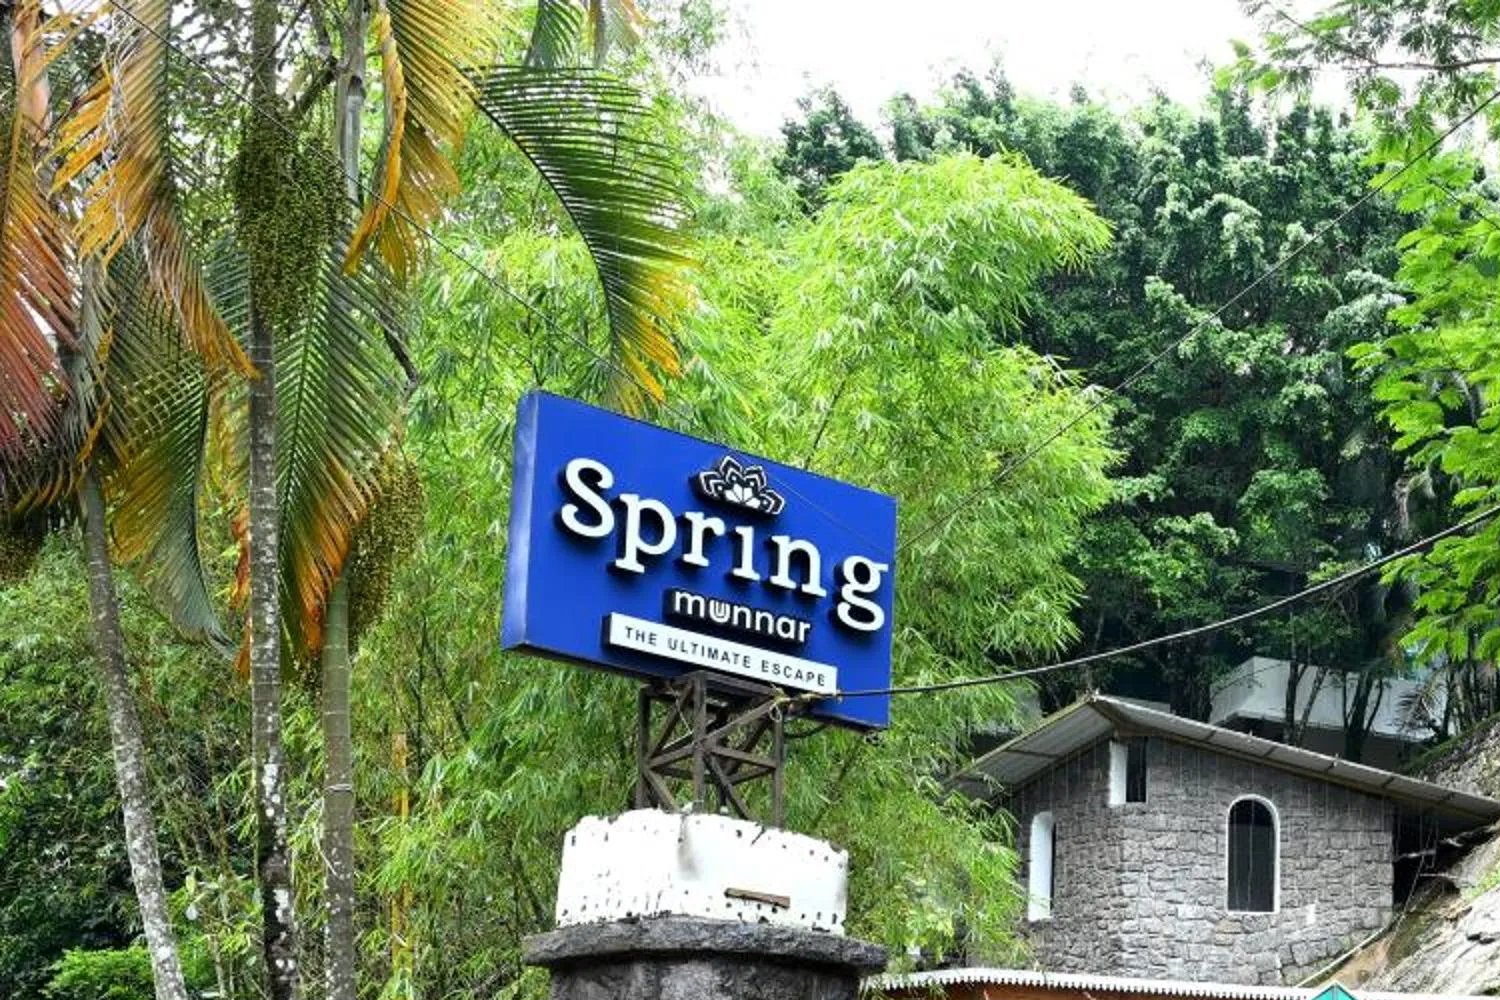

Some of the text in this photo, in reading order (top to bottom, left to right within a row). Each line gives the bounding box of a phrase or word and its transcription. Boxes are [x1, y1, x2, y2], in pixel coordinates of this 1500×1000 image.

[562, 458, 889, 631] Spring
[674, 591, 811, 642] munnar
[626, 626, 825, 686] THE ULTIMATE ESCAPE
